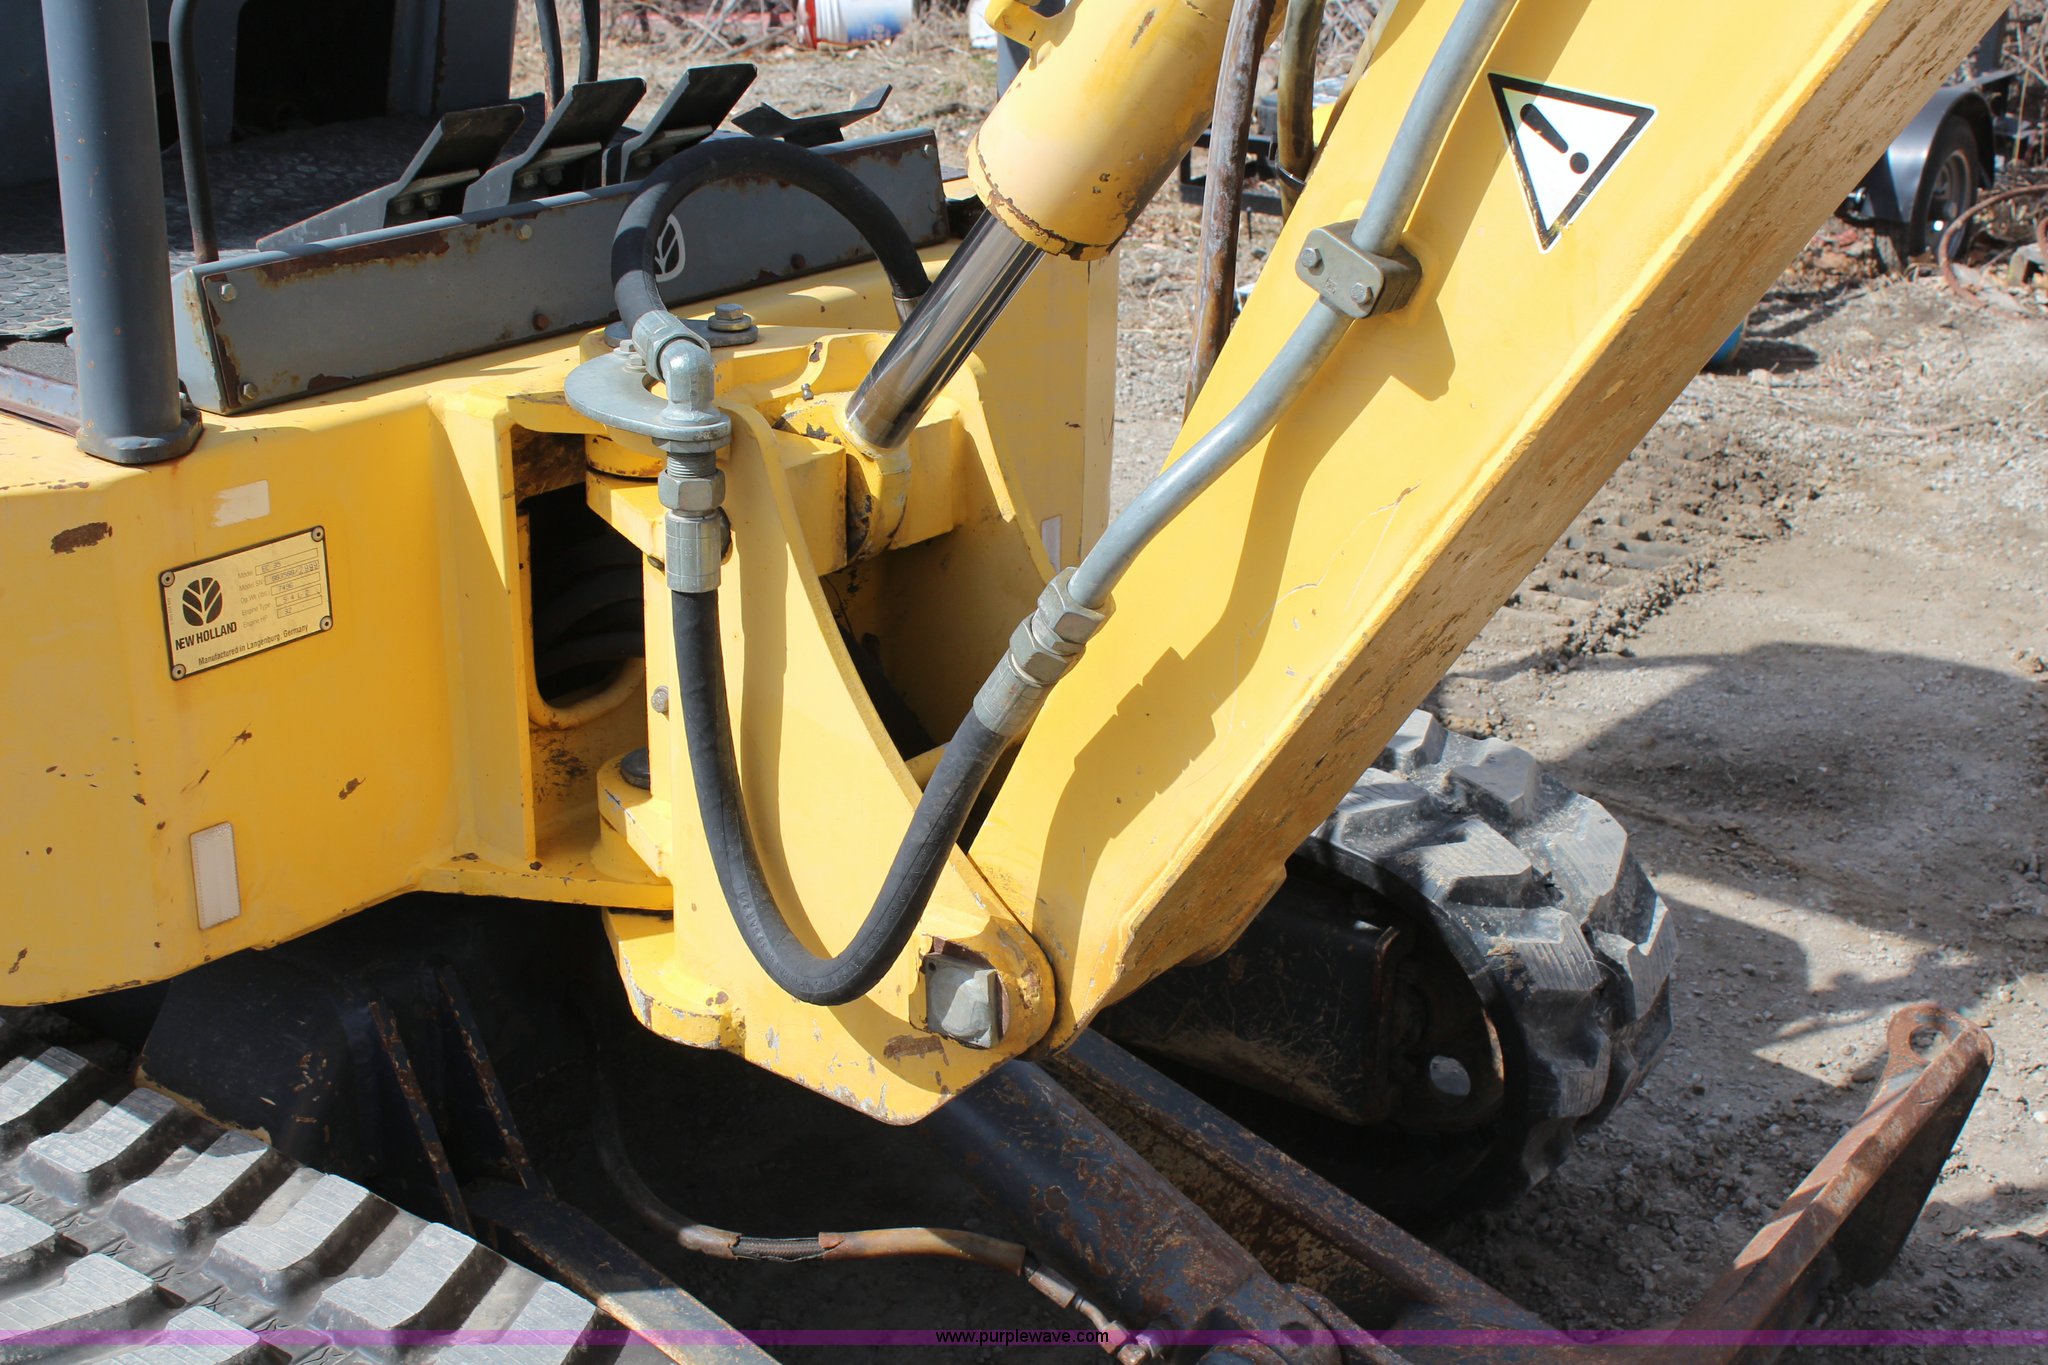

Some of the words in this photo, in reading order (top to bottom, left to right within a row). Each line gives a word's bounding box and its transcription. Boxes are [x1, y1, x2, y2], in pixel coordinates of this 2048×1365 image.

[175, 633, 195, 651] NEW
[196, 621, 237, 643] HOLLAND
[198, 644, 239, 666] Manufactured
[239, 642, 246, 652] in
[283, 624, 309, 638] Germany
